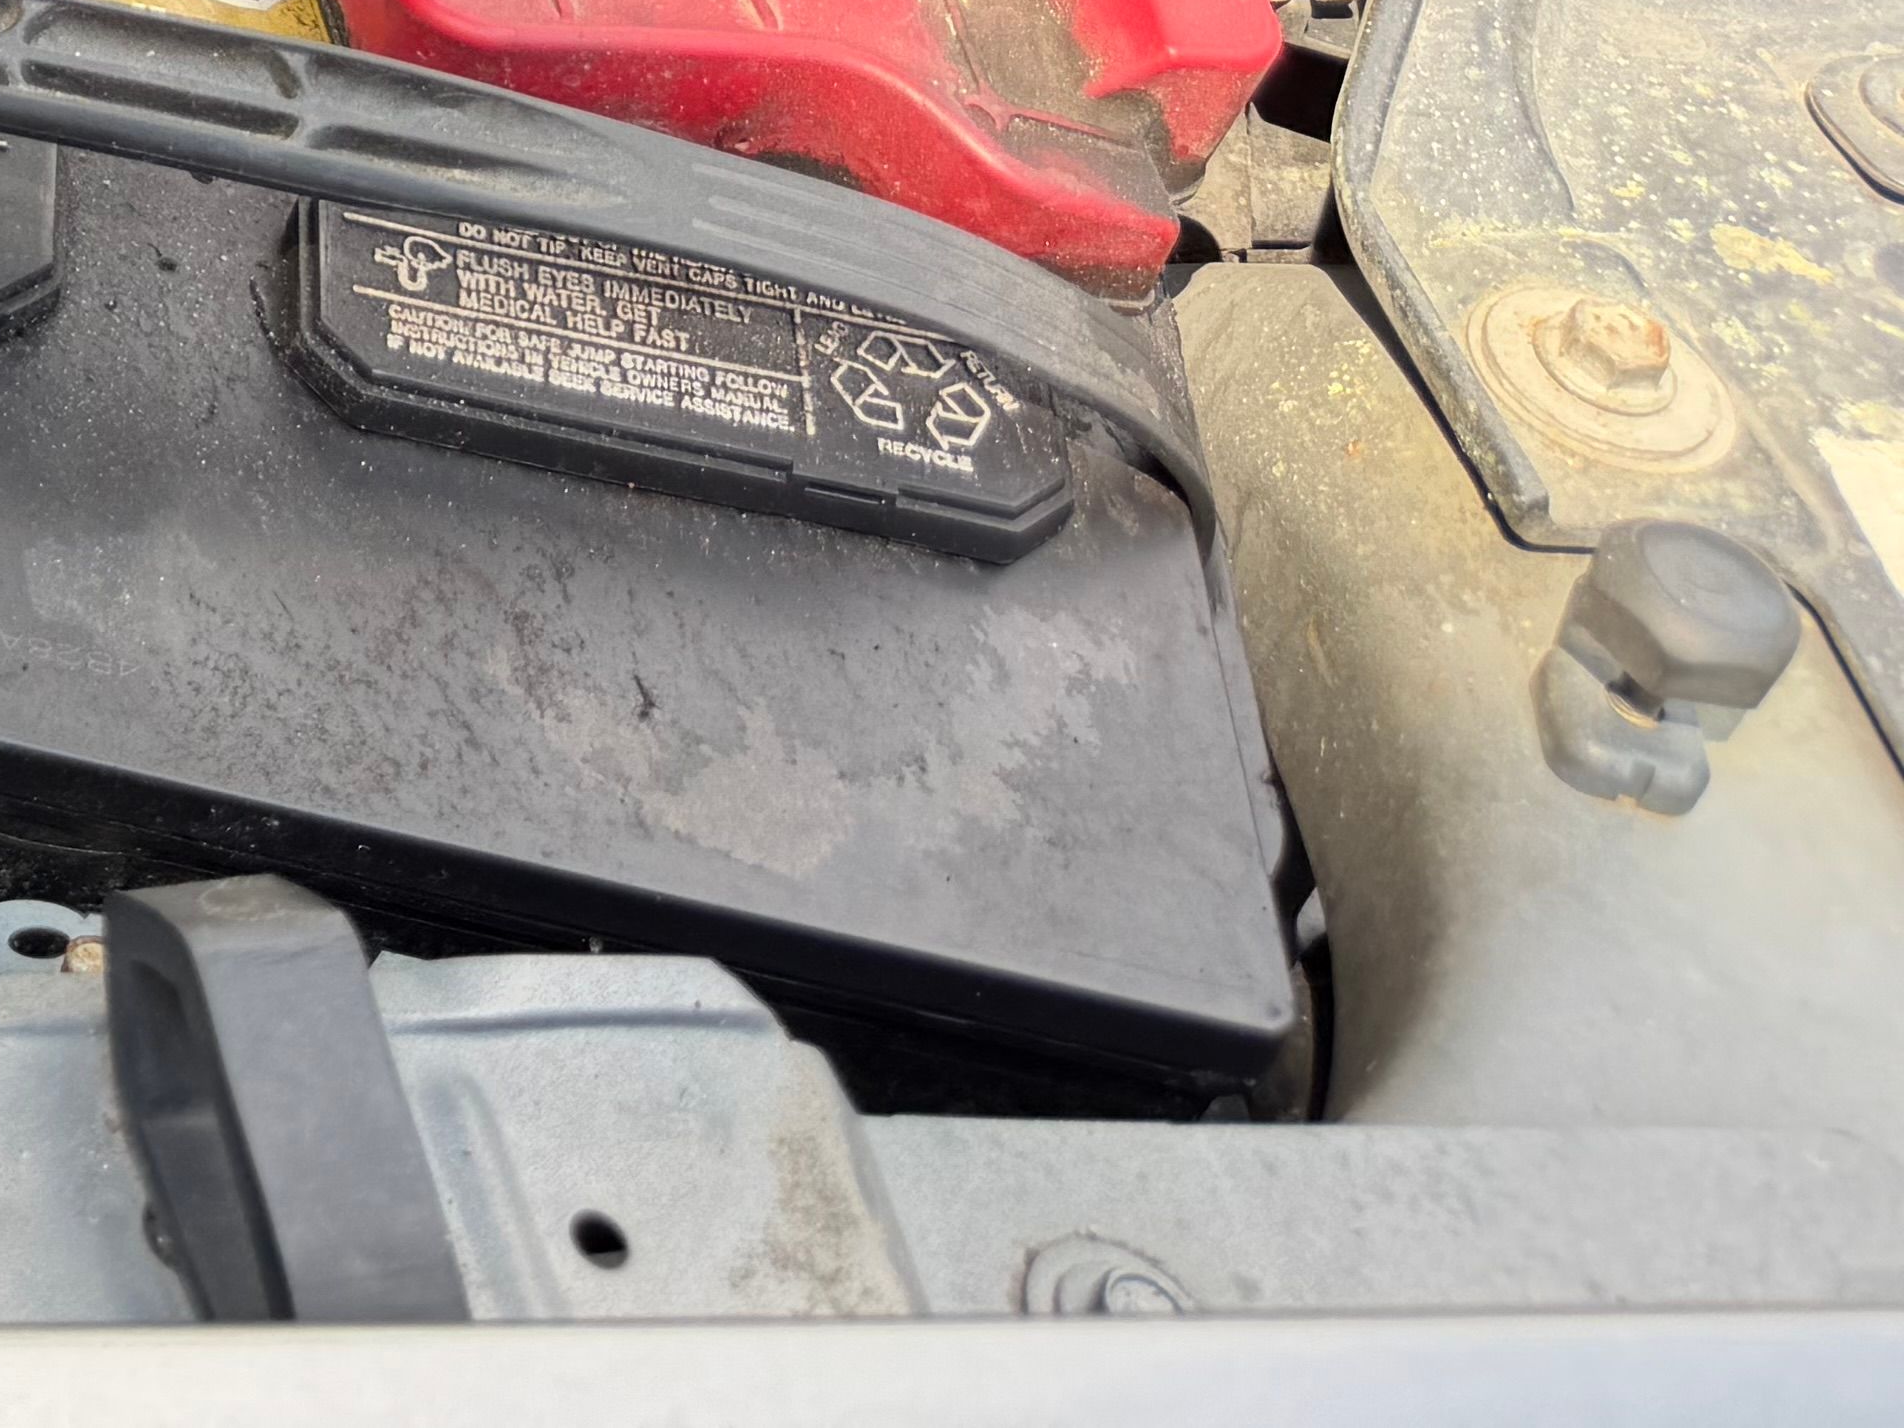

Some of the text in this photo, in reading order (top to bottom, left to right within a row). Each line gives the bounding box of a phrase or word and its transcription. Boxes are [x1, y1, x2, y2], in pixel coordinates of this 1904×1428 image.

[456, 249, 754, 324] FLUSH EYES IMMEDIATELY
[456, 269, 661, 325] WITH WATER. GET
[458, 222, 486, 240] DO
[493, 229, 532, 249] NOT
[581, 247, 628, 267] KEEP
[632, 256, 681, 277] VENT
[688, 267, 738, 290] CAPS
[743, 276, 799, 301] TIGHT
[458, 291, 690, 351] MEDICAL HELP FAST
[386, 334, 405, 350] IF
[408, 339, 448, 360] NOT
[452, 350, 545, 382] AVAILABLE
[548, 368, 596, 393] SEEK
[600, 381, 676, 407] SERVICE
[391, 320, 518, 358] INSTRUCTIONS
[524, 349, 544, 366] IN
[547, 352, 621, 382] VEHICLE
[626, 370, 705, 397] OWNERS
[475, 322, 512, 344] FOR
[518, 331, 561, 353] SAFE
[566, 343, 616, 364] JUMP
[620, 352, 710, 383] STARTING
[715, 370, 788, 399] FOLLOW
[959, 350, 1021, 412] RETURN
[877, 437, 974, 472] RECYCLE
